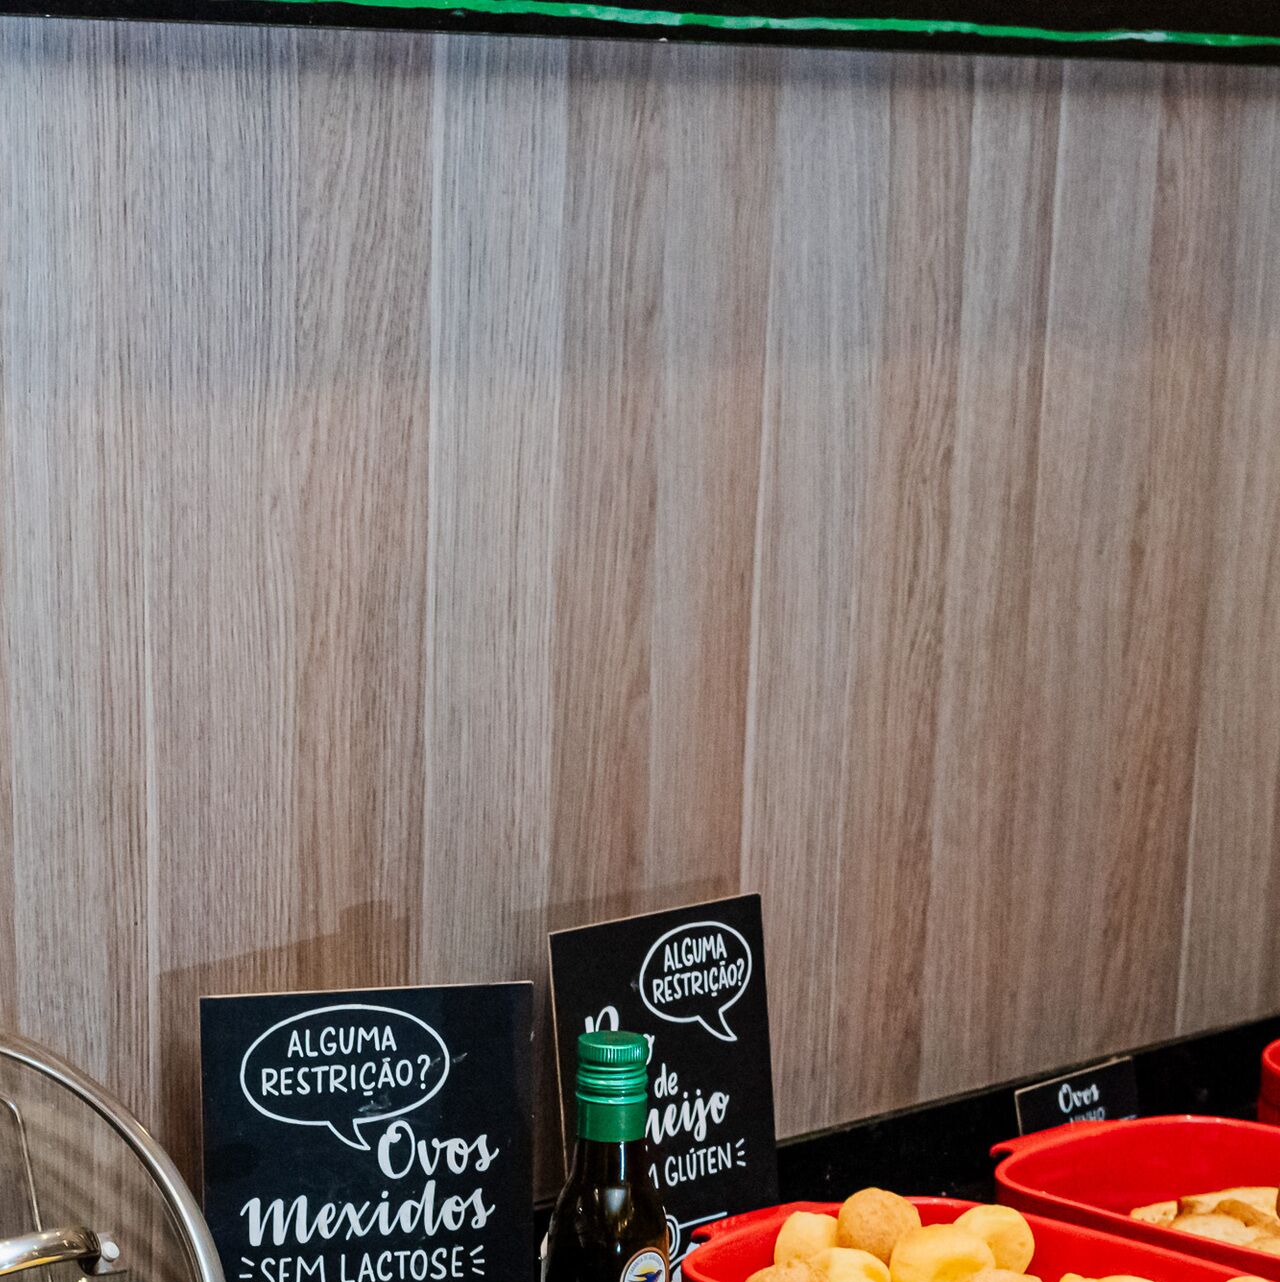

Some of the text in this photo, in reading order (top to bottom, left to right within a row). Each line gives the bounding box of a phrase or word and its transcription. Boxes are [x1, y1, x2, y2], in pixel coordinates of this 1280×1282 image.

[664, 932, 728, 973] ALGUMA
[652, 958, 745, 1004] RESTRIÇÃO?
[287, 1025, 397, 1058] ALGUMA
[654, 1063, 679, 1098] de
[1058, 1083, 1100, 1114] Ovos
[378, 1120, 500, 1179] Ovos
[665, 1142, 732, 1187] GLÚTEN
[240, 1179, 496, 1247] Mexidos
